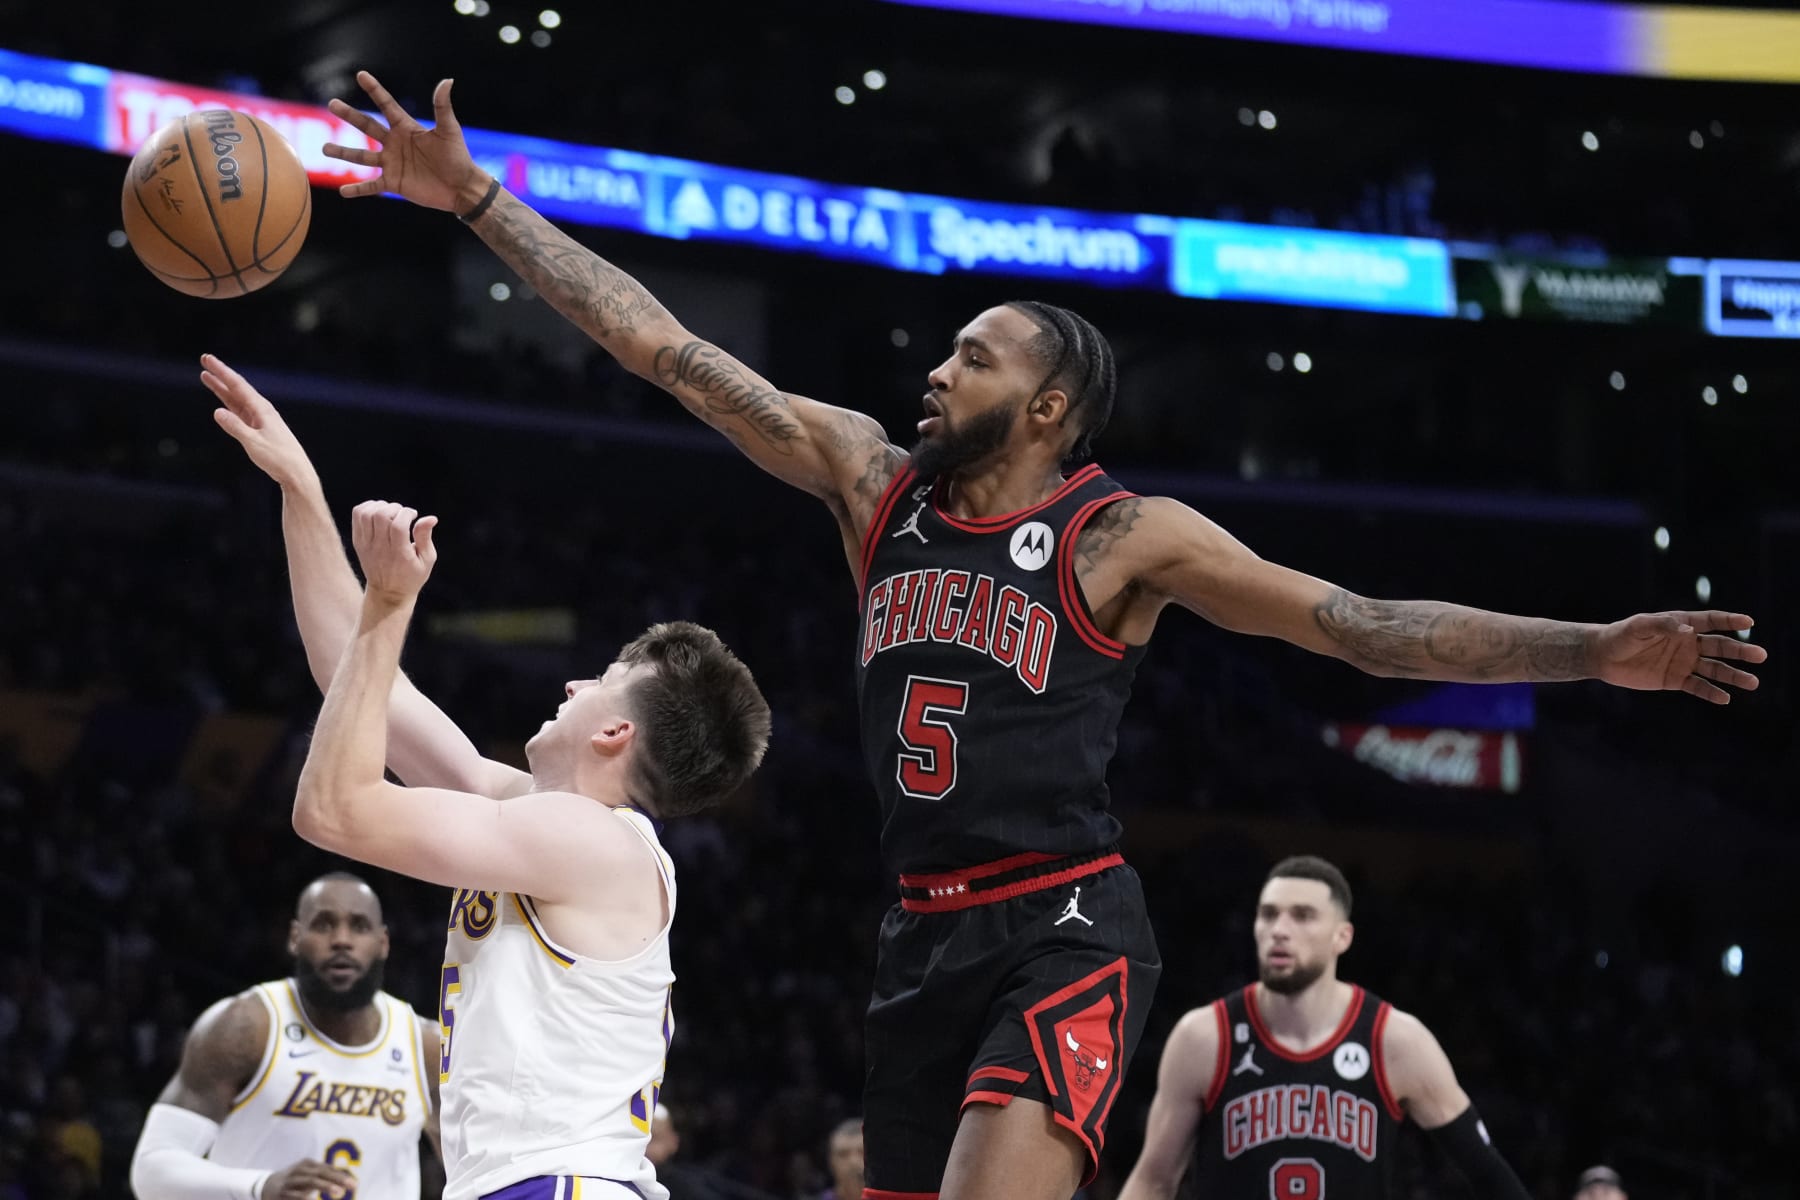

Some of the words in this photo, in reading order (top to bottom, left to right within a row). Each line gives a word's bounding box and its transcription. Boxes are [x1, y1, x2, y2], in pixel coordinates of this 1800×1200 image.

[201, 109, 244, 204] Wilson
[529, 160, 642, 210] ULTRA
[723, 184, 890, 250] DELTA
[930, 206, 1141, 273] Spectrum
[861, 568, 1058, 694] CHICAGO
[896, 674, 969, 800] 5
[272, 1070, 406, 1126] LAKERS
[1223, 1083, 1378, 1163] CHICAGO
